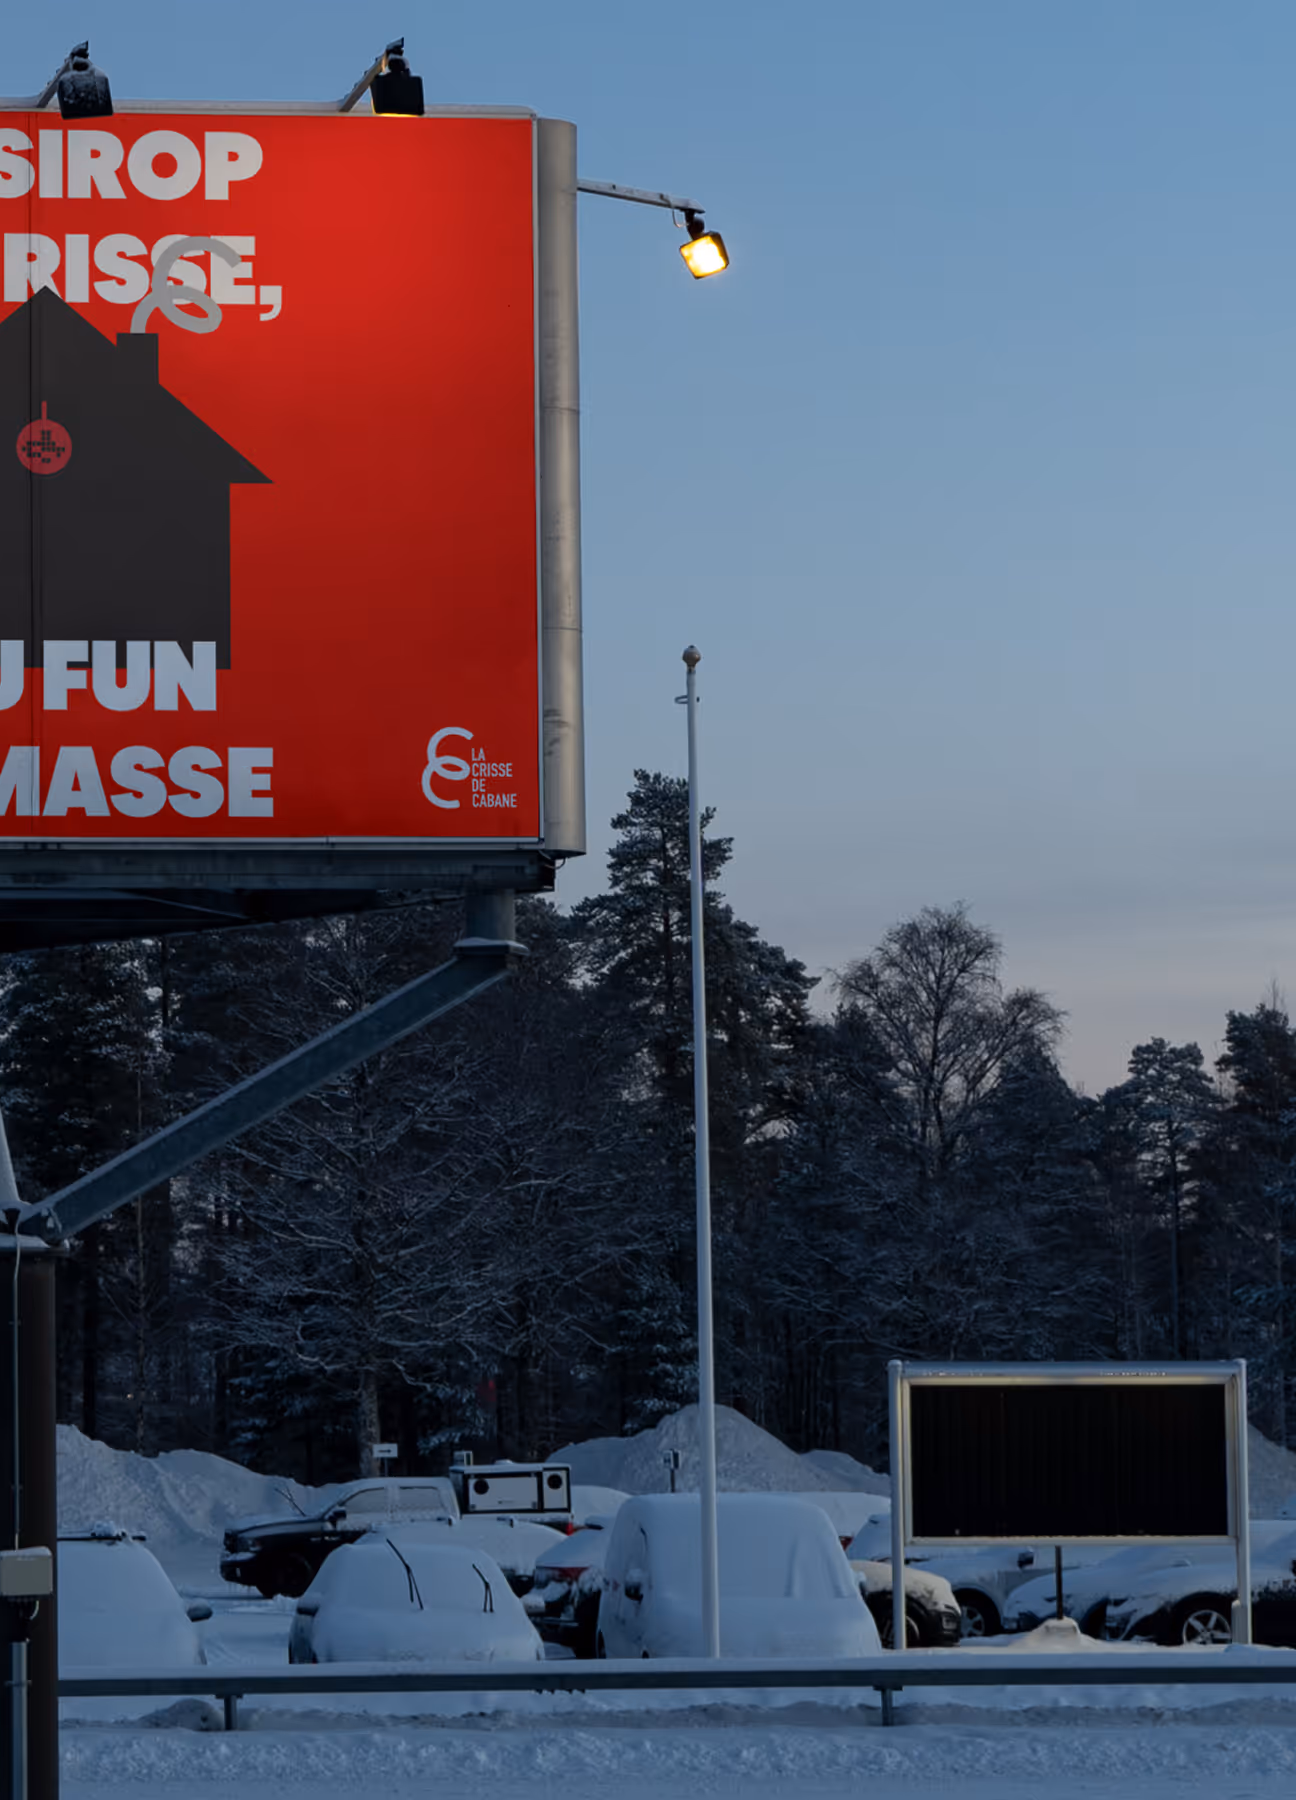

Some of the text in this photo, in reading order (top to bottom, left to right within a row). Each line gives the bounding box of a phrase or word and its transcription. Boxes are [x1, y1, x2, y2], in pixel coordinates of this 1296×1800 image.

[43, 640, 217, 711] FUN
[471, 747, 486, 761] LA
[471, 762, 513, 777] CRISSE
[471, 778, 486, 792] DE
[472, 793, 517, 808] CABANE
